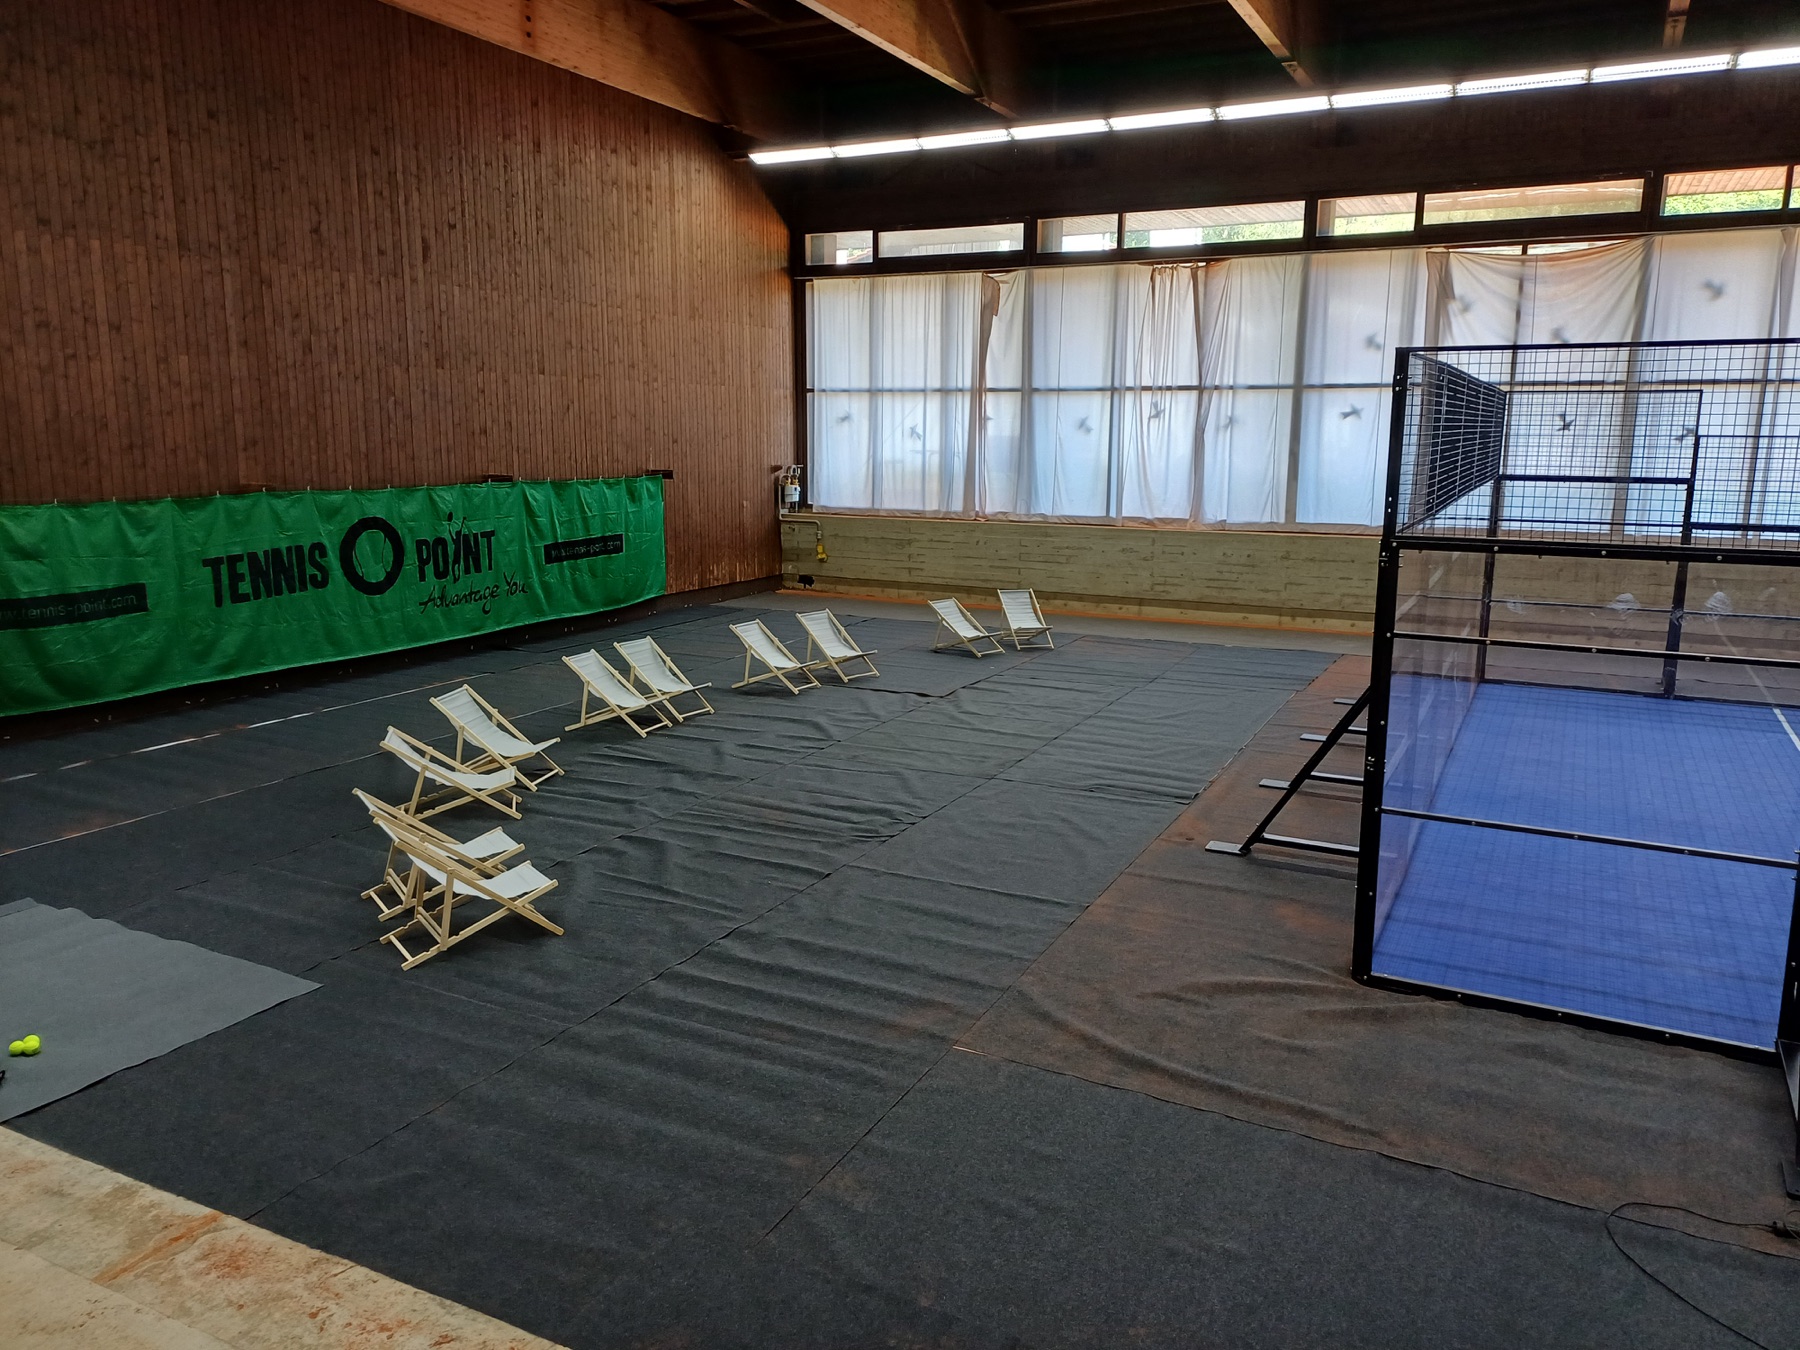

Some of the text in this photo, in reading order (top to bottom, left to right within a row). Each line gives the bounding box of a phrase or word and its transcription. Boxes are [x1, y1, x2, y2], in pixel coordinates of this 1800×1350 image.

[202, 527, 496, 607] TENNIS POINT
[418, 570, 529, 616] Advantage You
